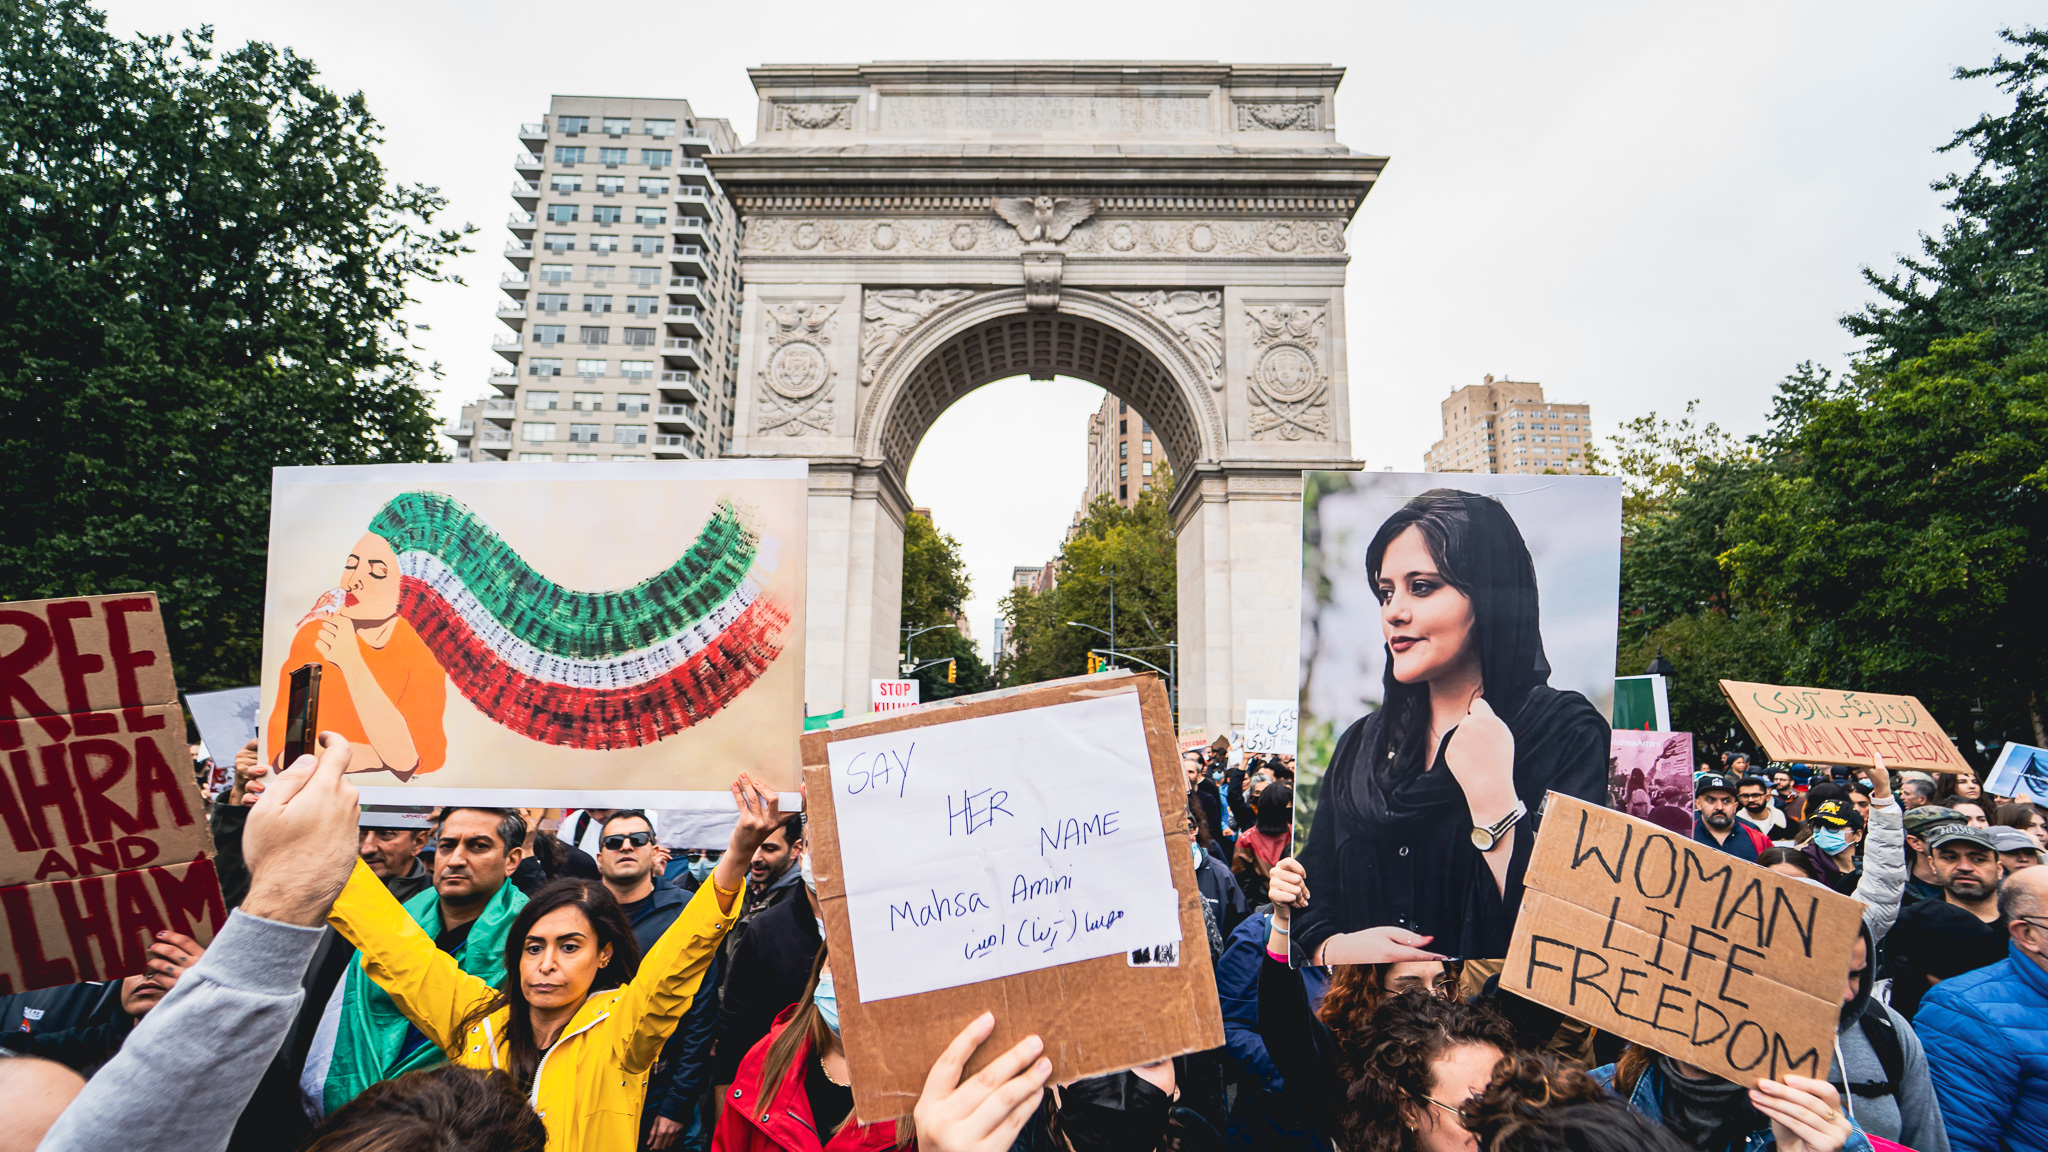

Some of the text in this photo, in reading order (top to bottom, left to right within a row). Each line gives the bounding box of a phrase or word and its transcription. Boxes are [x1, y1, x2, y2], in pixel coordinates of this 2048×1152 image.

[889, 109, 1200, 119] AND THE HONEST CAN REPAIR THE EVENT
[904, 120, 917, 129] IN
[921, 120, 947, 129] THE
[953, 120, 994, 129] HAND
[999, 120, 1017, 129] OF
[1023, 120, 1053, 129] GOD
[1110, 120, 1201, 129] WASHINGTON
[936, 99, 971, 109] RAISE
[977, 99, 988, 109] A
[992, 99, 1063, 109] STANDARD
[1067, 99, 1085, 109] TO
[1089, 99, 1132, 109] WHICH
[1137, 99, 1163, 109] THE
[1168, 99, 1201, 109] WISE
[0, 597, 166, 750] REE
[880, 683, 910, 696] STOP
[847, 742, 916, 798] SAY
[1876, 729, 1963, 768] FREEDOM
[0, 736, 195, 853] AHRA
[947, 787, 1014, 836] HER
[34, 836, 160, 880] AND
[1040, 810, 1121, 857] NAME
[890, 864, 1073, 931] Mahsa Amini
[1570, 809, 1819, 957] WOMAN
[0, 851, 229, 996] LHAM
[1601, 896, 1766, 1009] LIFE
[1526, 934, 1820, 1079] FREEDOM
